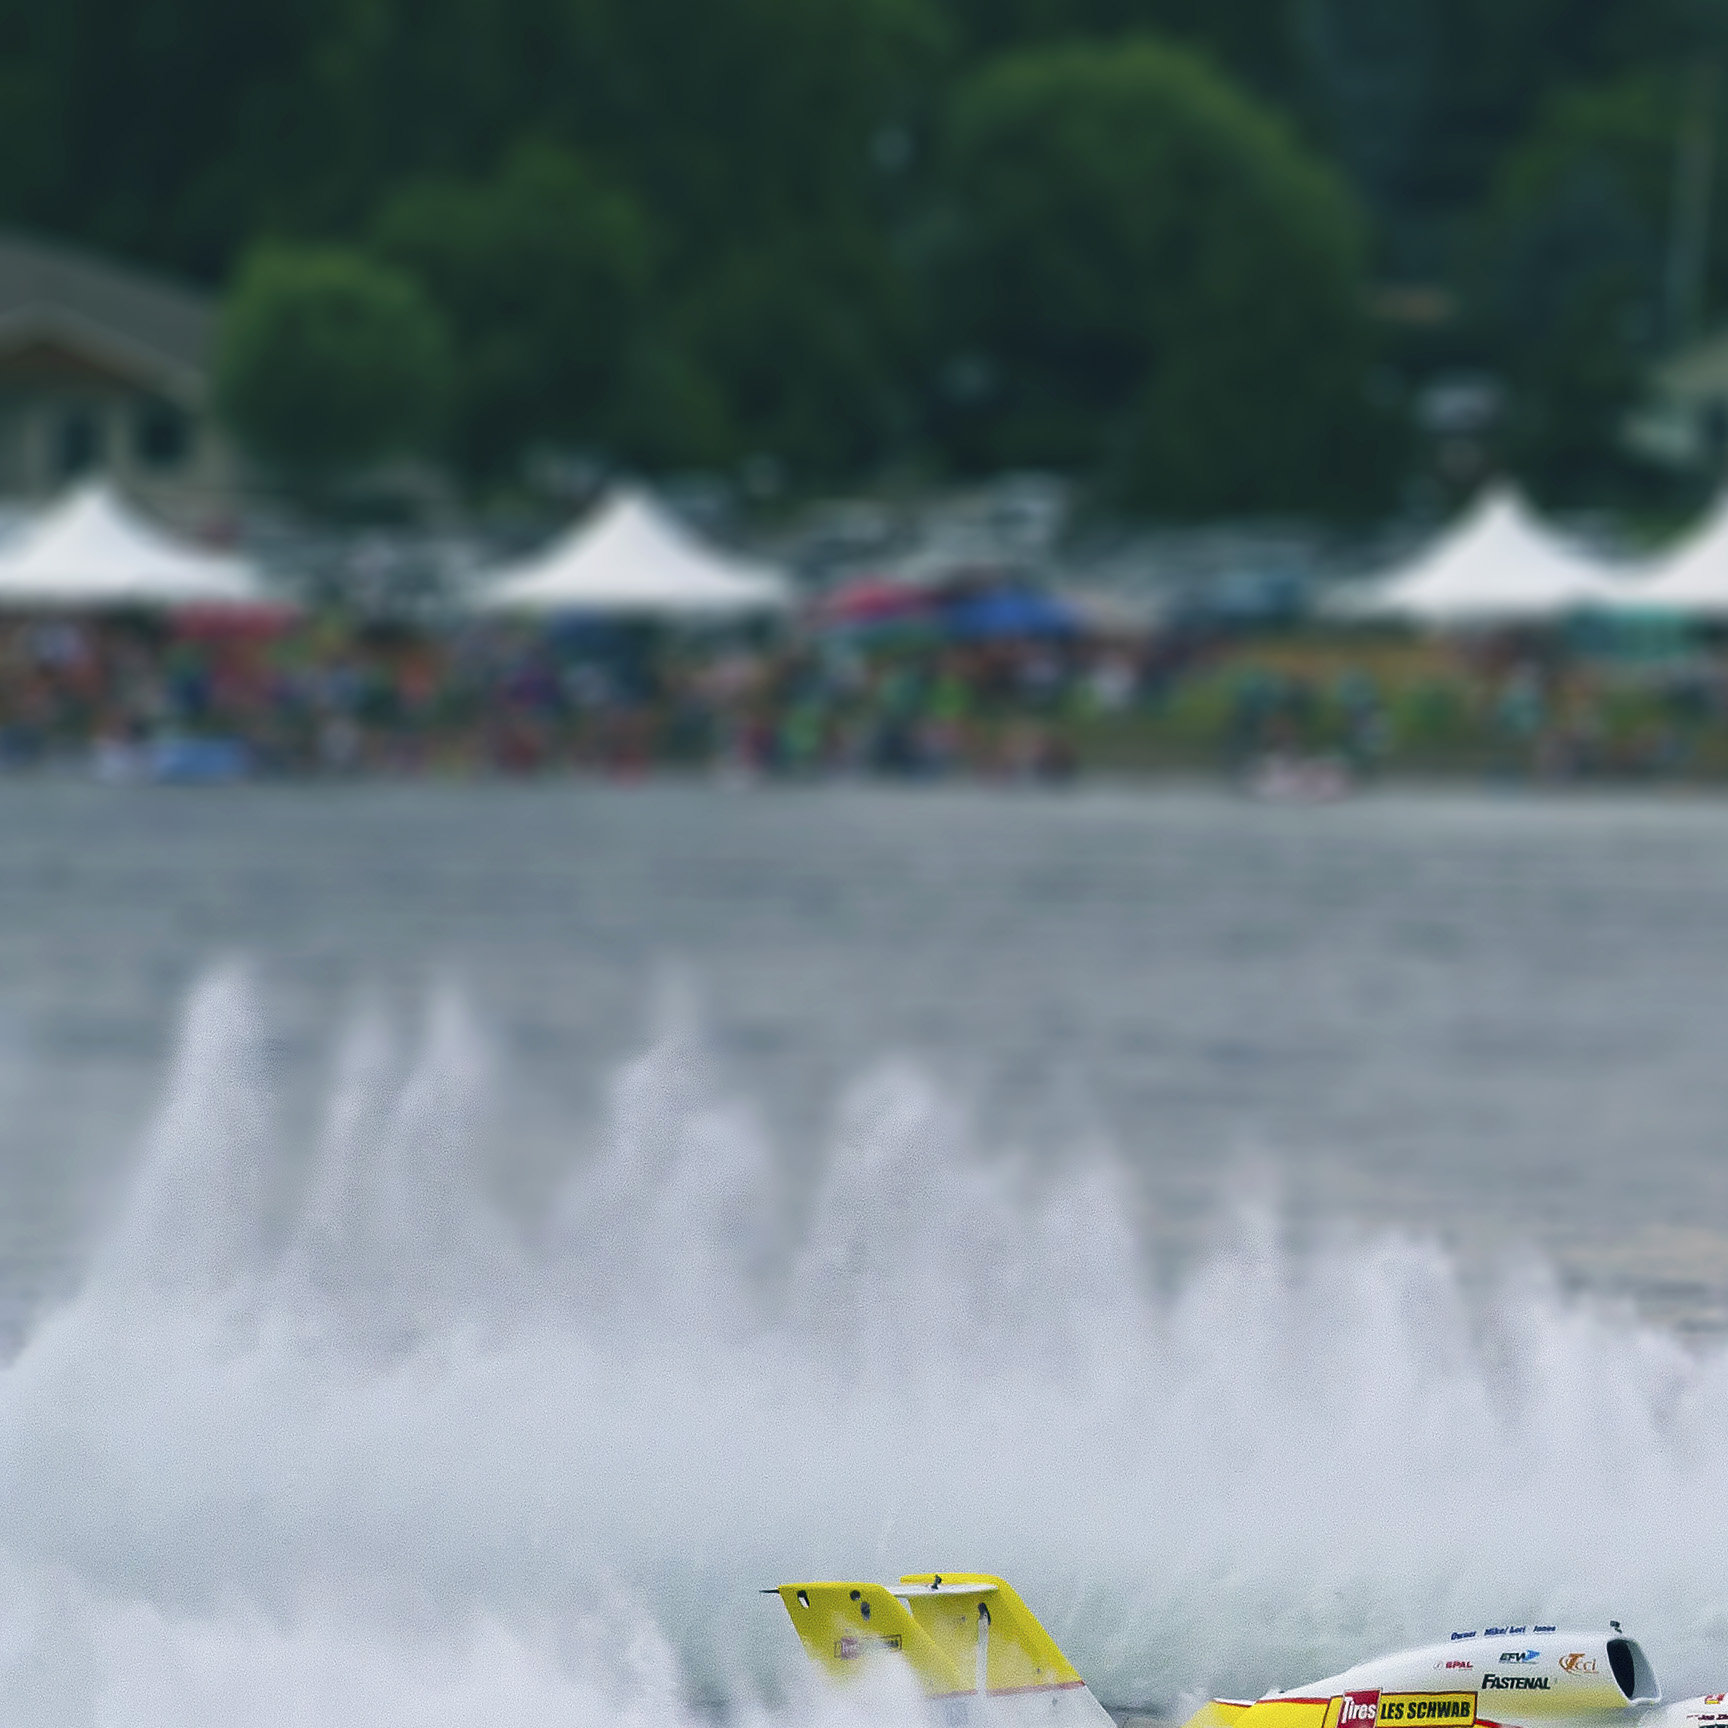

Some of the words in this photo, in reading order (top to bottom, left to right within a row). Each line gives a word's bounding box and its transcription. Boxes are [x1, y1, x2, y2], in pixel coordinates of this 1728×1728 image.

[1481, 1674, 1551, 1690] FASTENAL
[1341, 1696, 1377, 1724] Tires
[1380, 1702, 1405, 1720] LES
[1407, 1701, 1471, 1719] SCHWAB
